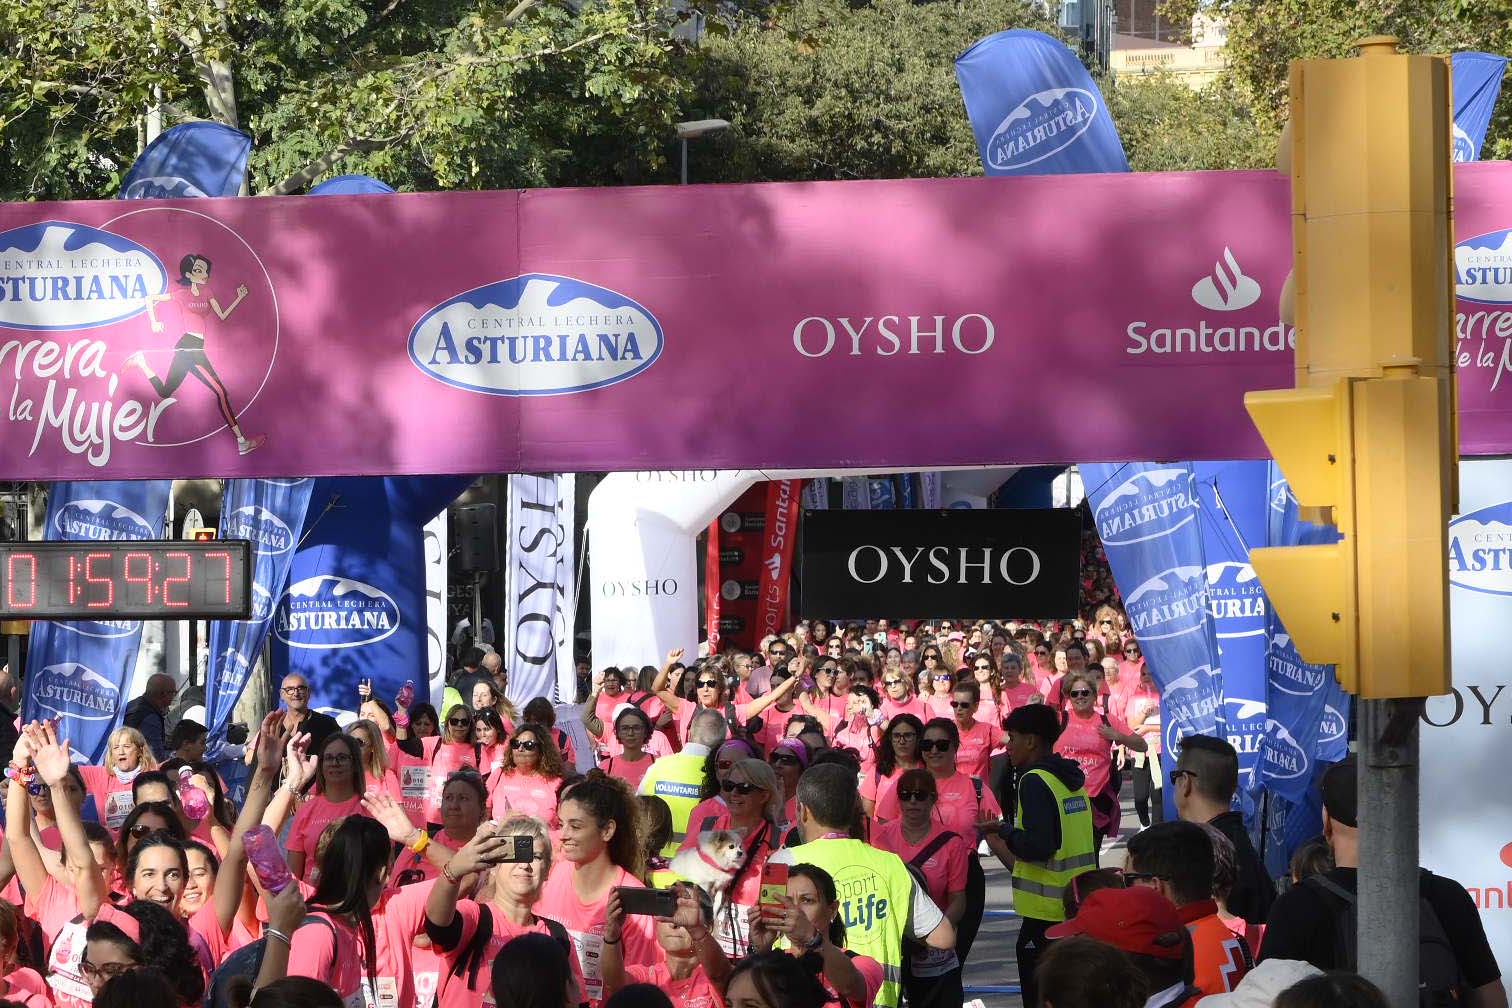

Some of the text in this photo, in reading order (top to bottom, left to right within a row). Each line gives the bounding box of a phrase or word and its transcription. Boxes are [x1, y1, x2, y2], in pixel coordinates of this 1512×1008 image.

[70, 257, 142, 269] LECHERA
[467, 314, 635, 330] CENTRAL LECHERA
[794, 312, 997, 359] OYSHO
[428, 321, 643, 365] ASTURIANA
[9, 382, 33, 422] la
[28, 373, 178, 467] Mujer
[8, 552, 231, 608] 01:59:27
[847, 544, 1041, 586] OYSHO
[601, 578, 679, 598] OYSHO
[278, 602, 391, 632] ASTURIANA
[290, 599, 386, 610] CENTRAL LECHERA
[37, 684, 115, 713] ASTURIANA
[1420, 684, 1512, 728] OY
[655, 782, 699, 796] VOLUNTARIS
[404, 801, 424, 810] UMA
[842, 893, 888, 932] Life
